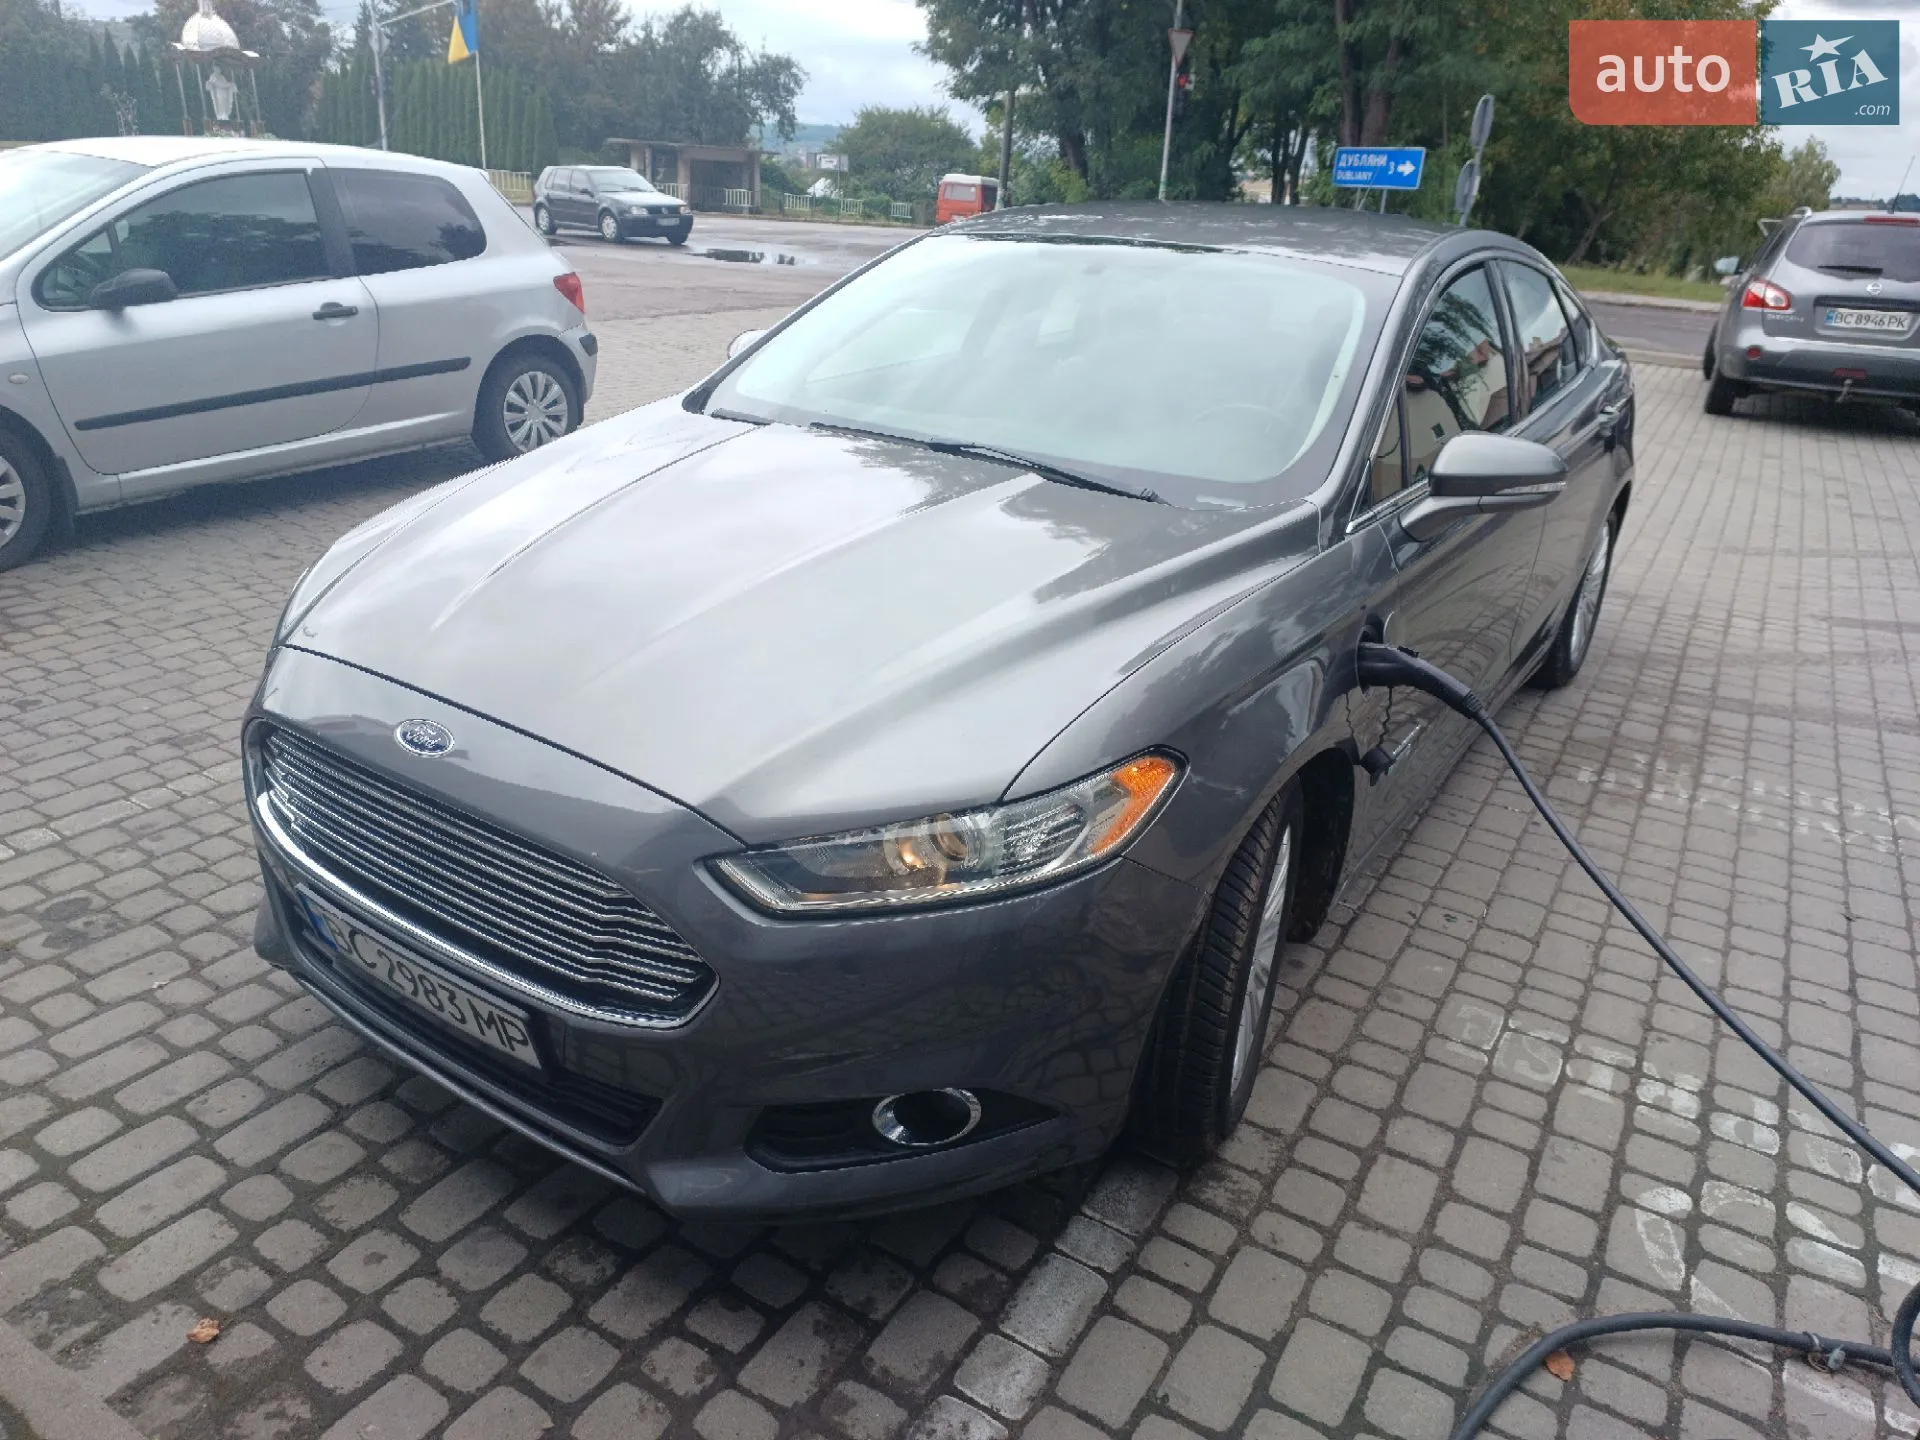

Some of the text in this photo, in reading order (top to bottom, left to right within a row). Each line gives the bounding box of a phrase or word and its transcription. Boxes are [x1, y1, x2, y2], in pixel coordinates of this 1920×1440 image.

[1834, 312, 1907, 328] BC 8946 PK
[323, 914, 529, 1051] BC 2983 MP
